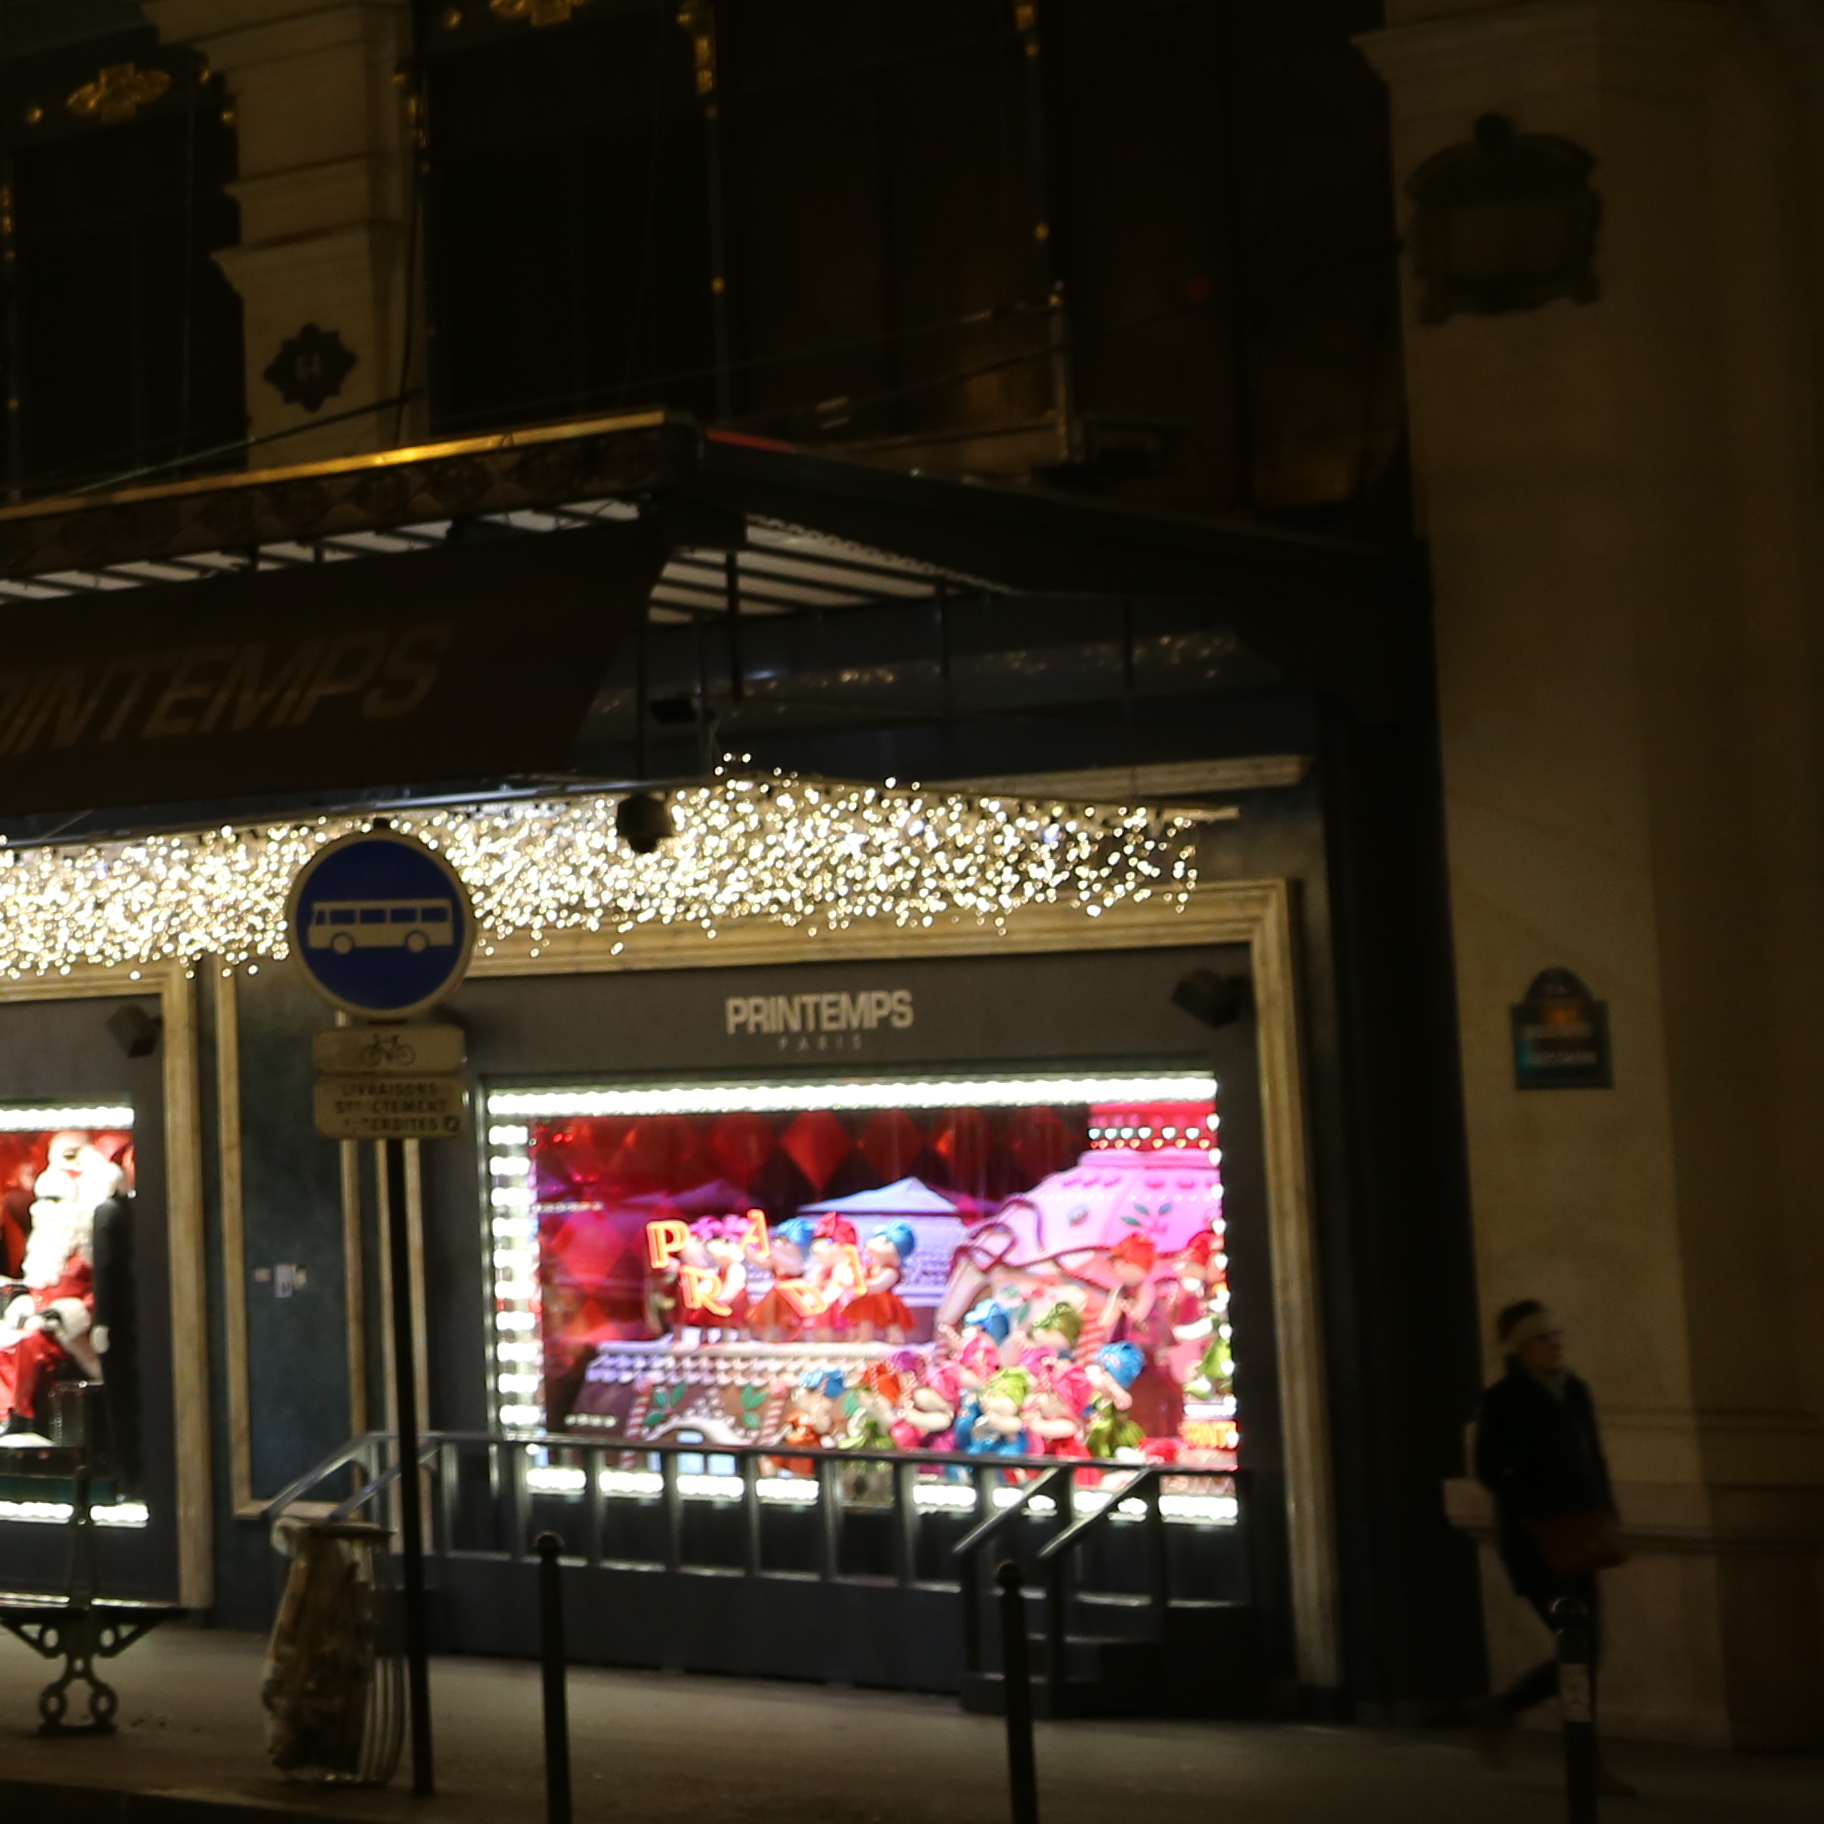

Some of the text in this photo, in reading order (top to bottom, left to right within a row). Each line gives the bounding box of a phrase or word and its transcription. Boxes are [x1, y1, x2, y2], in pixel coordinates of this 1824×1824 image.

[725, 989, 914, 1035] PRINTEMPS
[778, 1035, 862, 1051] PARIS
[341, 1083, 438, 1096] LIVRAISONS
